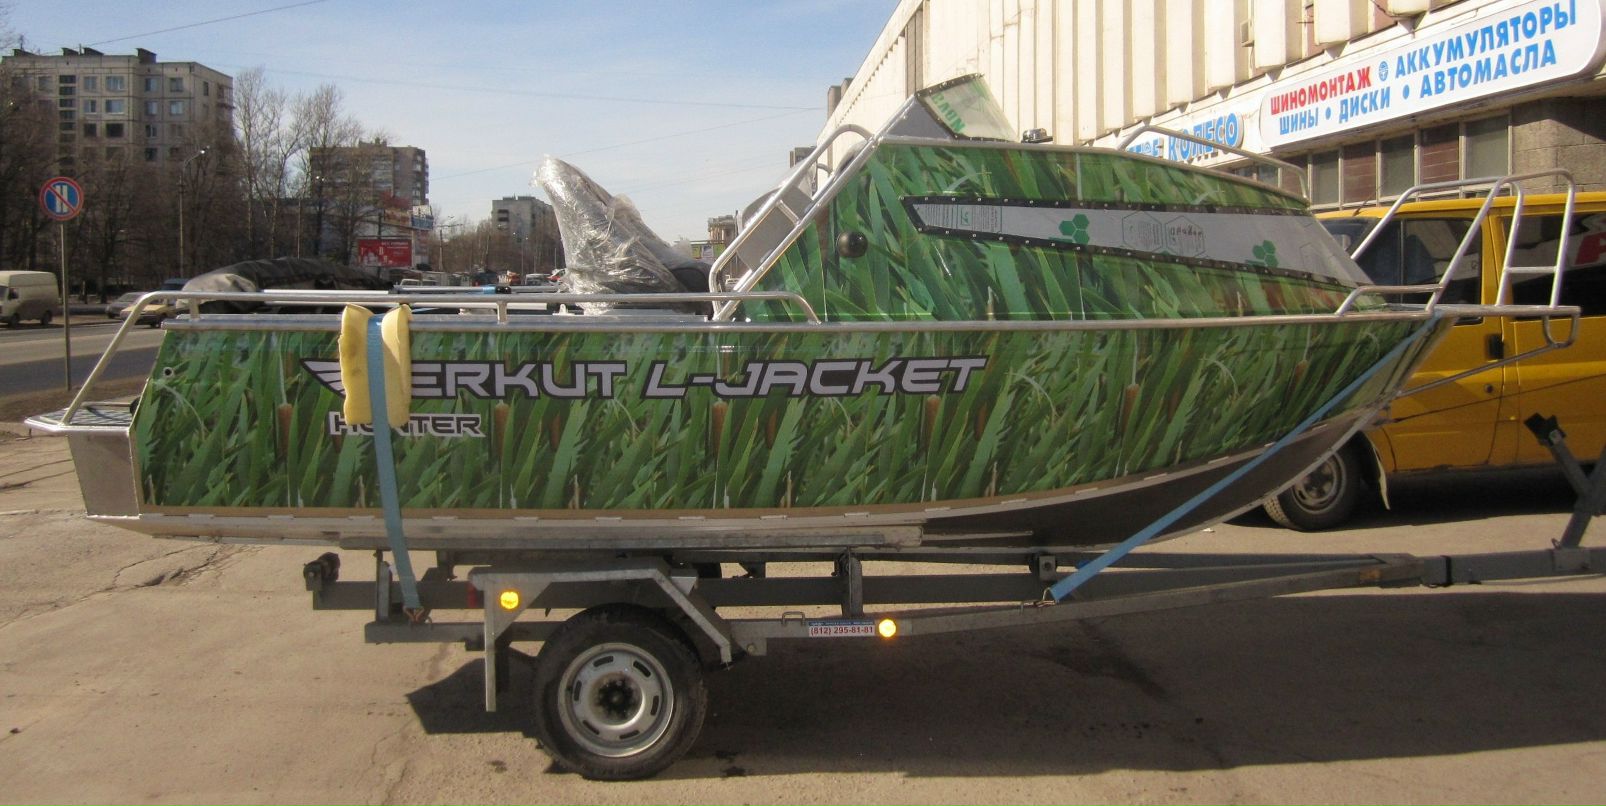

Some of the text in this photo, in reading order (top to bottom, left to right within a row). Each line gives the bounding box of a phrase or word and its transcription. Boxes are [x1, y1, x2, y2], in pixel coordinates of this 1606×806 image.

[1270, 0, 1577, 116] ШИНОМОНТАЖ АККУМУЛЯТОРЫ
[1279, 38, 1557, 136] ШИНЫ ДИСКИ АВТОМАСЛА
[1168, 112, 1239, 162] КОЛЕСО
[410, 357, 987, 400] ERKUT L-JACKET
[329, 411, 485, 437] HTER
[811, 626, 873, 635] (812) 295-81-81
